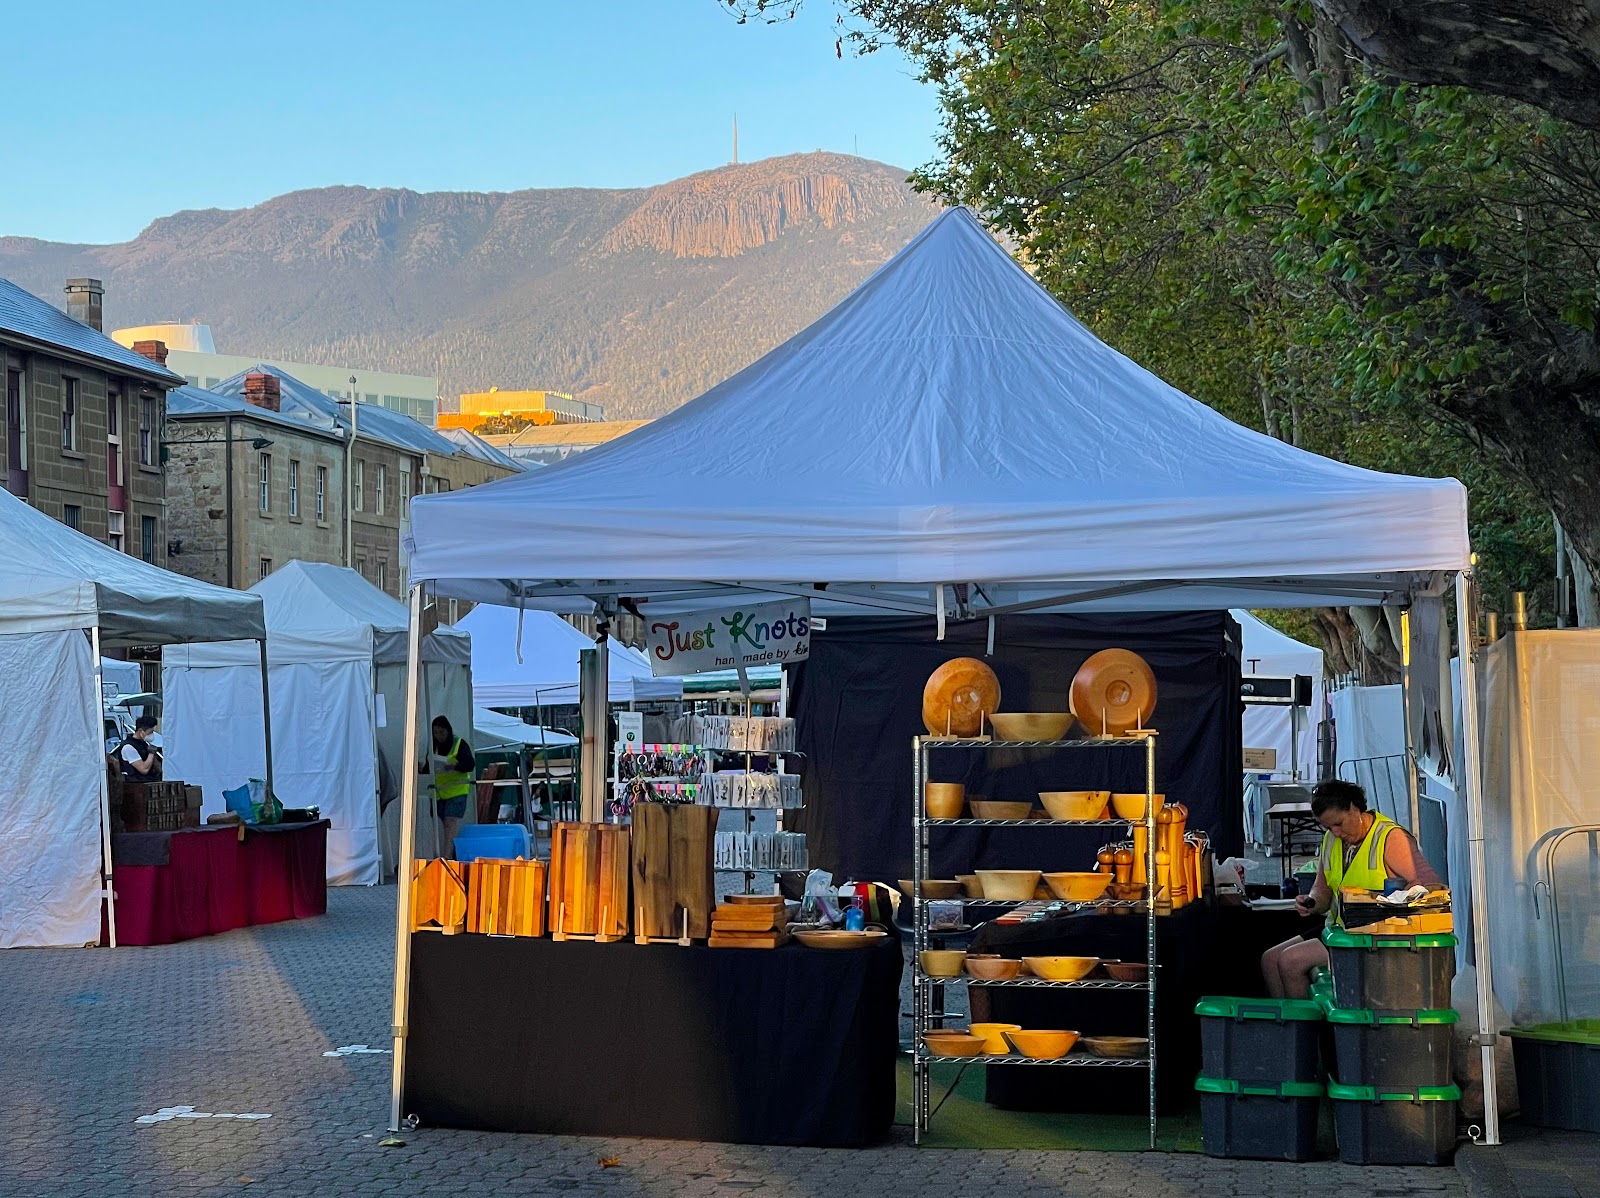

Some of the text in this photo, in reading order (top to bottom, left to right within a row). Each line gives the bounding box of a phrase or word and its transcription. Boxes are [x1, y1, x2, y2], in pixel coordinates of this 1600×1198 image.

[651, 611, 808, 660] Just Knots
[776, 648, 790, 661] by
